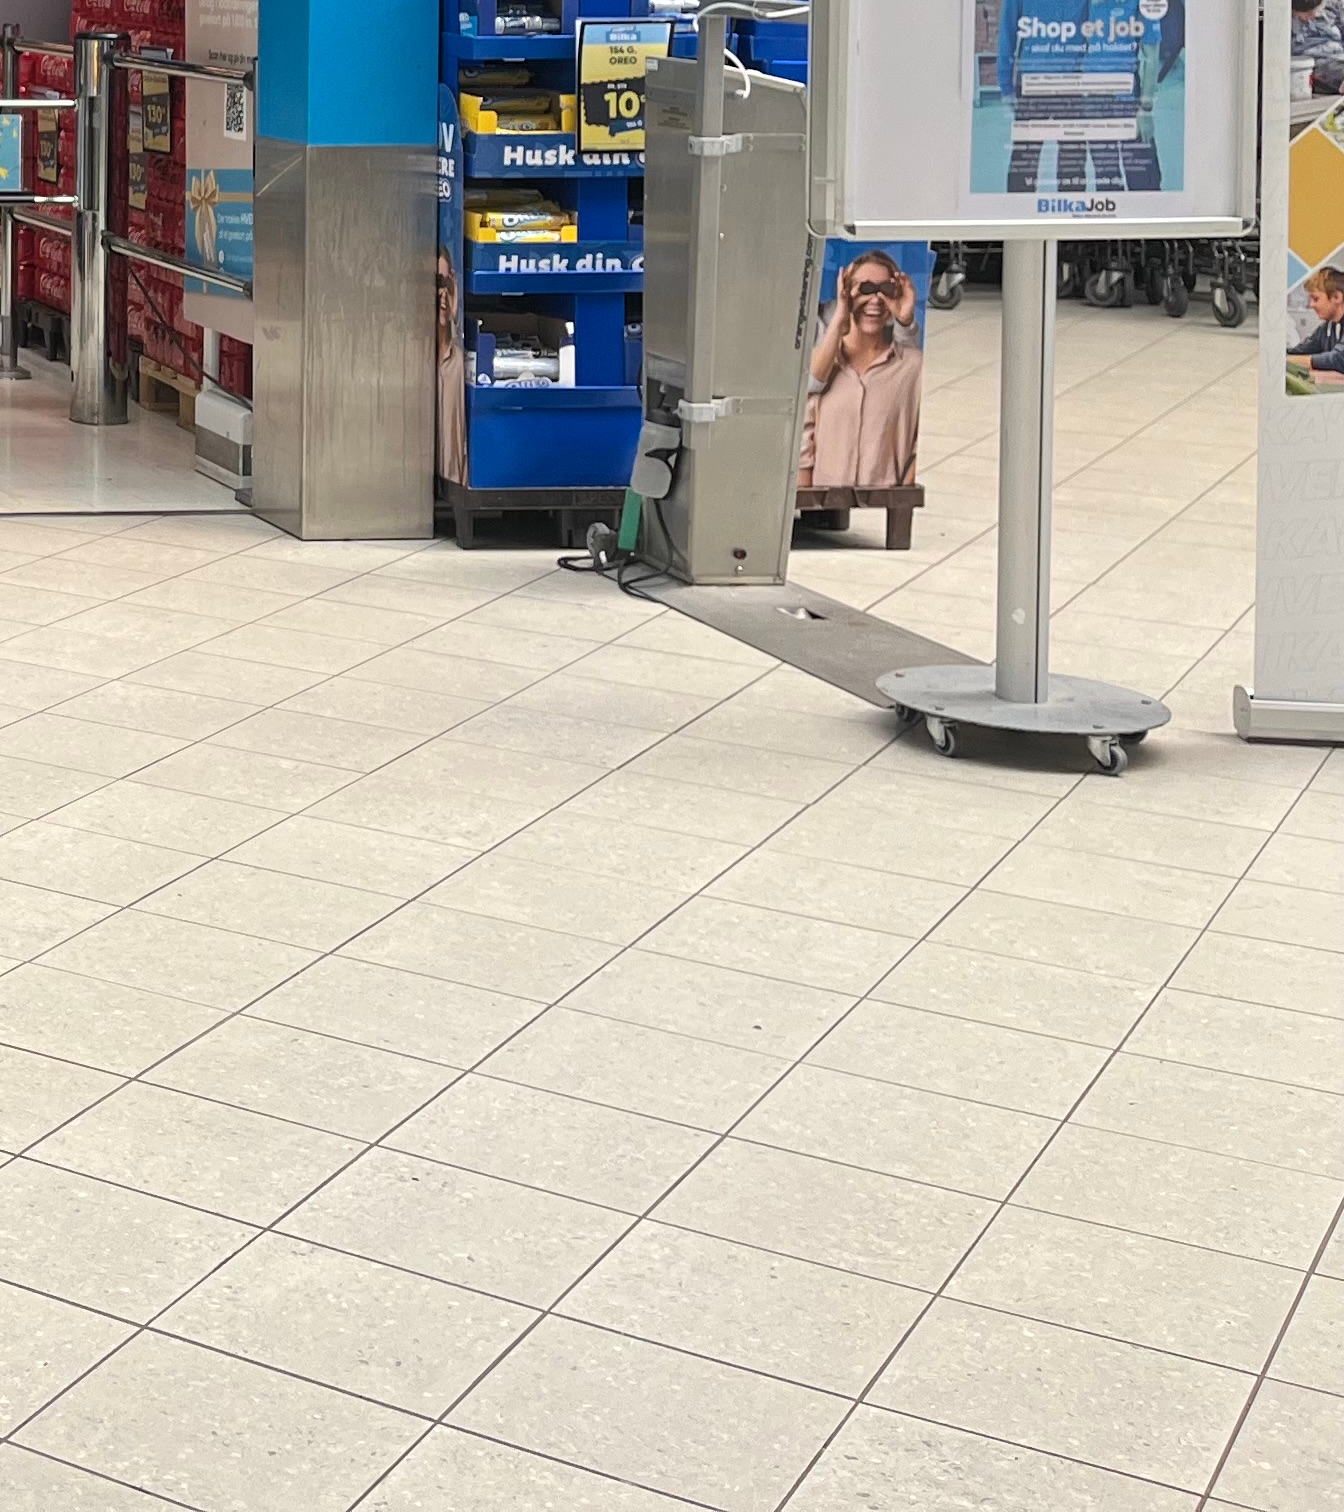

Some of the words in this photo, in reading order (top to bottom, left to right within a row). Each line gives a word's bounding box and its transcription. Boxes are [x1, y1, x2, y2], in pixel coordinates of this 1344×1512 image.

[1017, 15, 1076, 42] Shop
[1081, 18, 1105, 39] et
[1109, 16, 1145, 43] job
[609, 56, 637, 64] OREO
[604, 90, 640, 118] 10
[504, 144, 575, 166] Husk
[1037, 198, 1116, 213] BilkaJob
[498, 253, 569, 272] Husk
[576, 253, 622, 272] din
